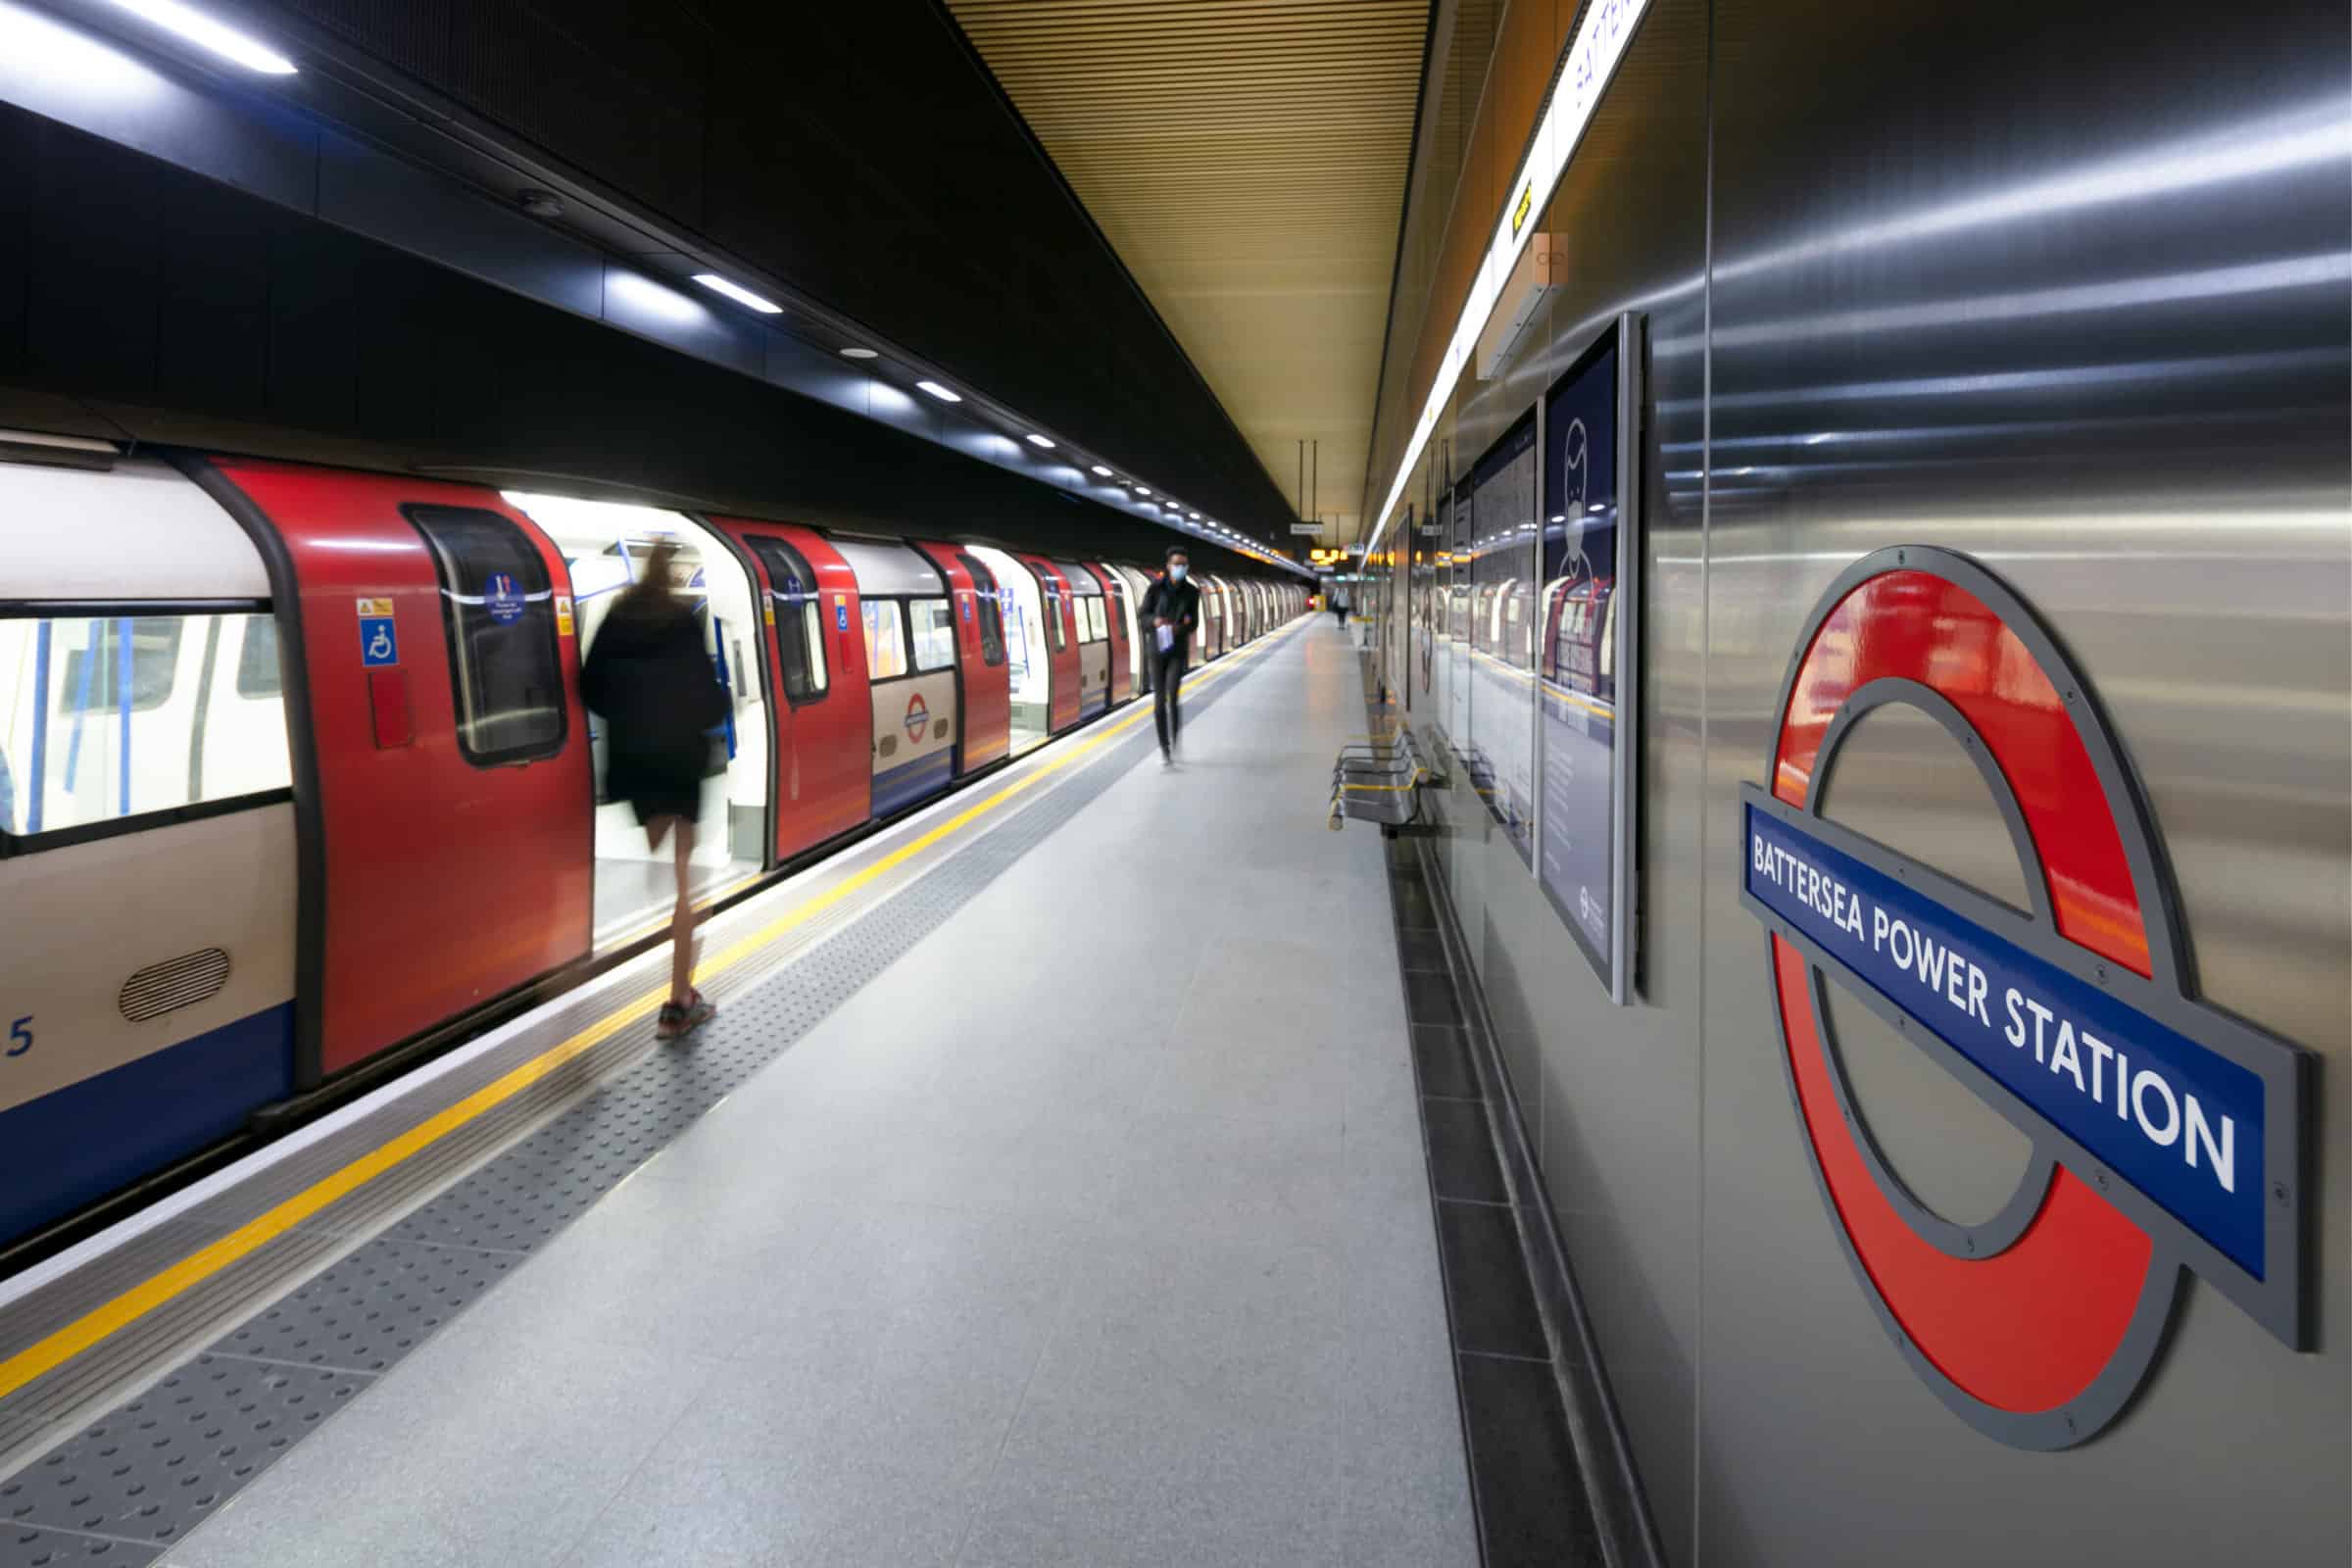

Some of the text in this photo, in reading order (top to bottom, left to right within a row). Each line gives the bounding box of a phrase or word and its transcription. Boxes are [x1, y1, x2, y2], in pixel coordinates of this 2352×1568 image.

[1576, 0, 1630, 92] BATTE
[6, 1014, 33, 1057] 5
[1754, 834, 2235, 1194] BATTERSEA POWER STATION
